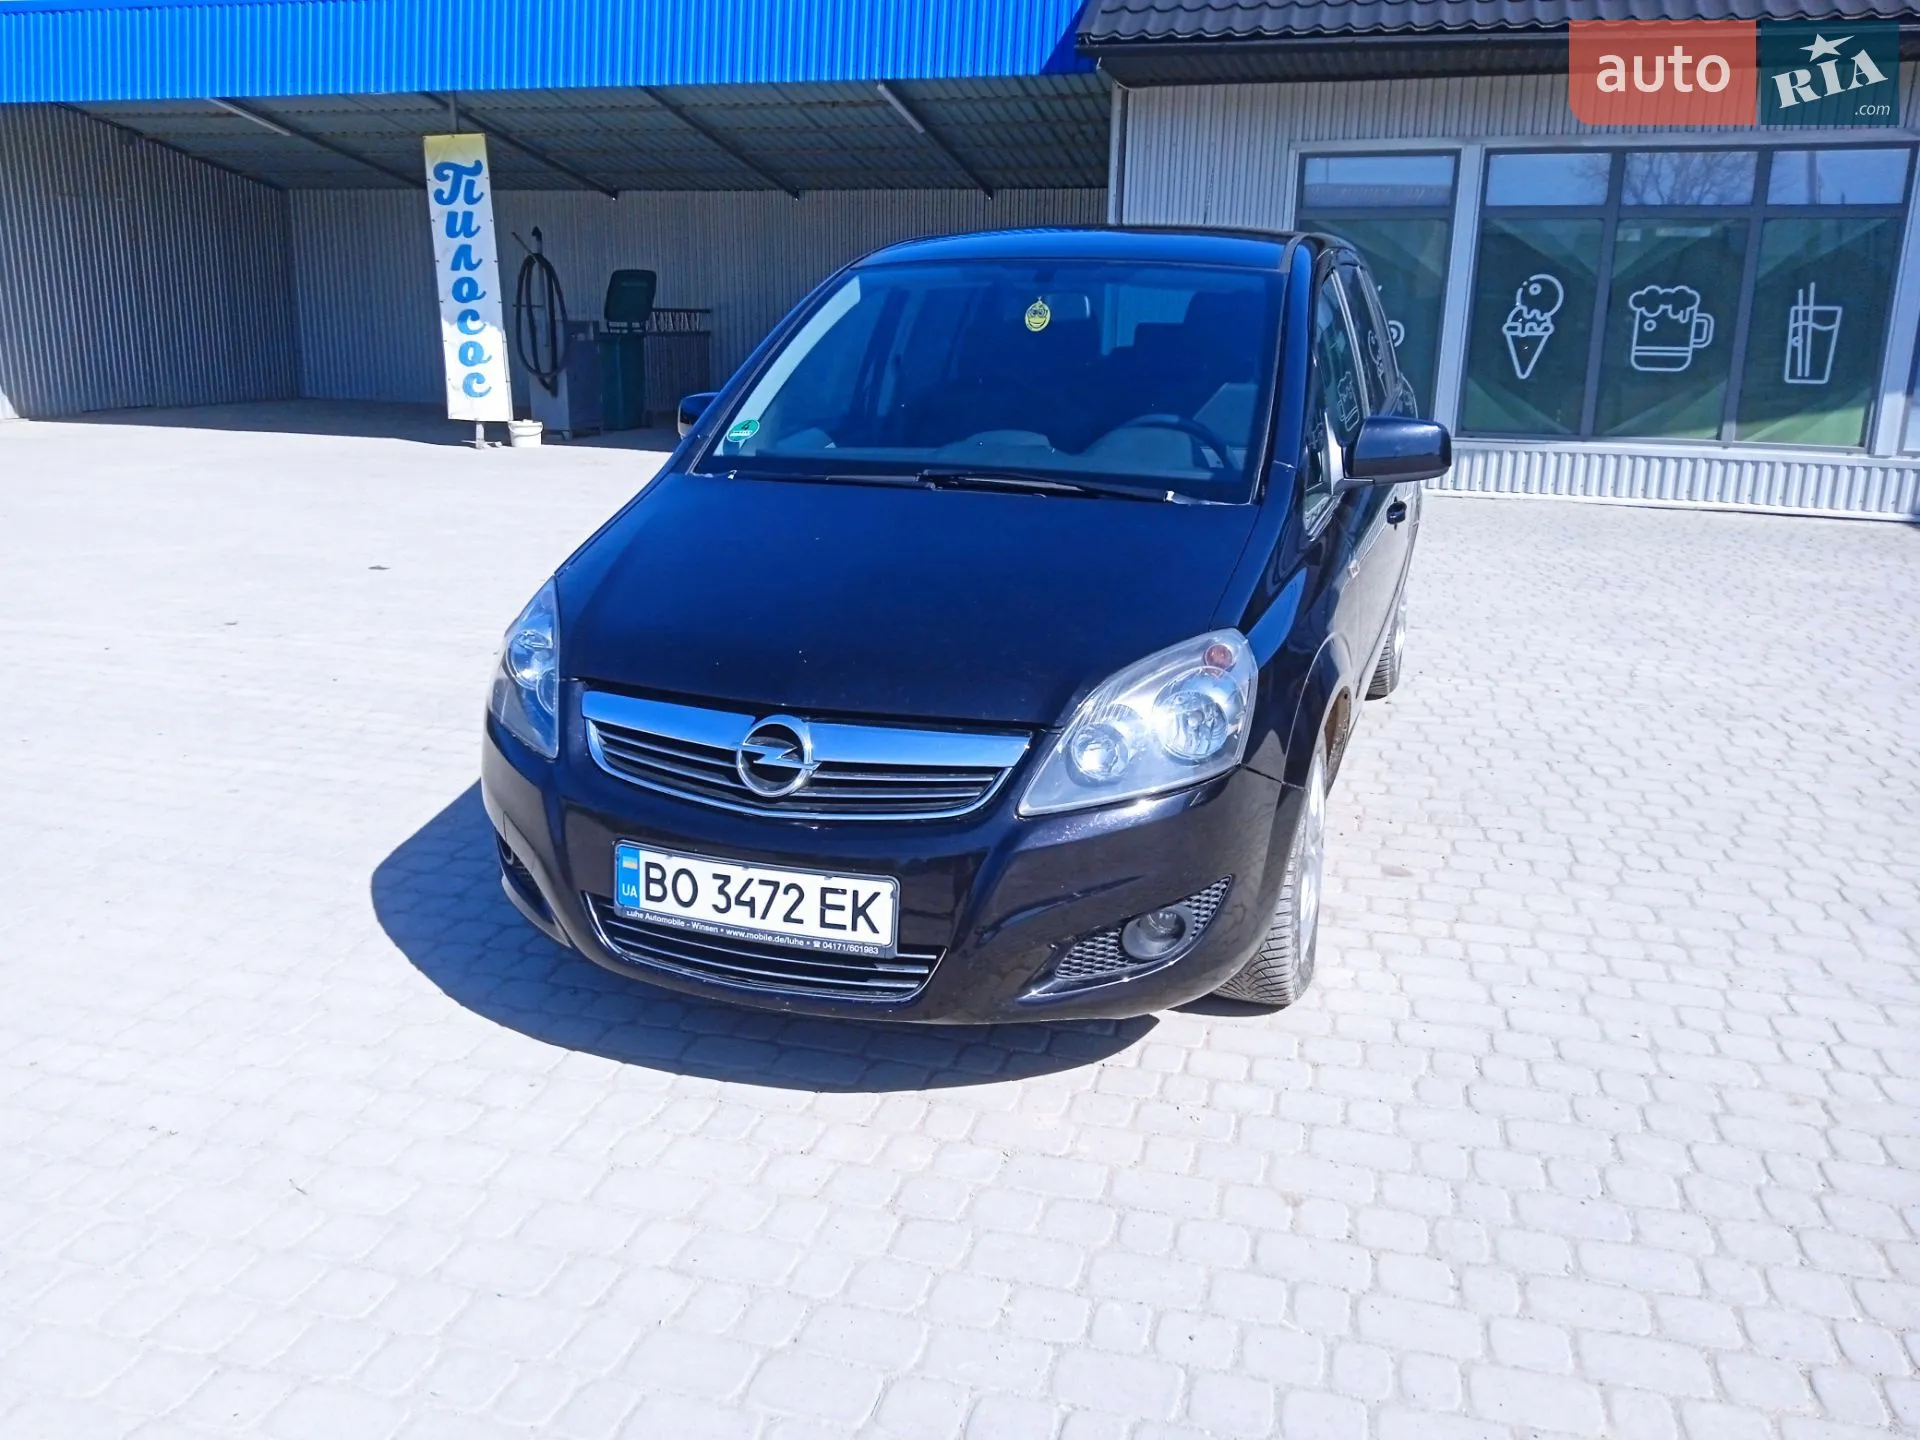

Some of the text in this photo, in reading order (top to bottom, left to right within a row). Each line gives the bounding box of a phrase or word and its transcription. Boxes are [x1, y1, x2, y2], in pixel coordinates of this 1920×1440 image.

[433, 160, 493, 398] Пилосос
[622, 884, 638, 898] UA
[645, 861, 881, 934] BO 3472 EK
[645, 912, 685, 927] Automobile
[691, 921, 719, 933] Winsen
[725, 928, 804, 946] www.mobile.de/luhe
